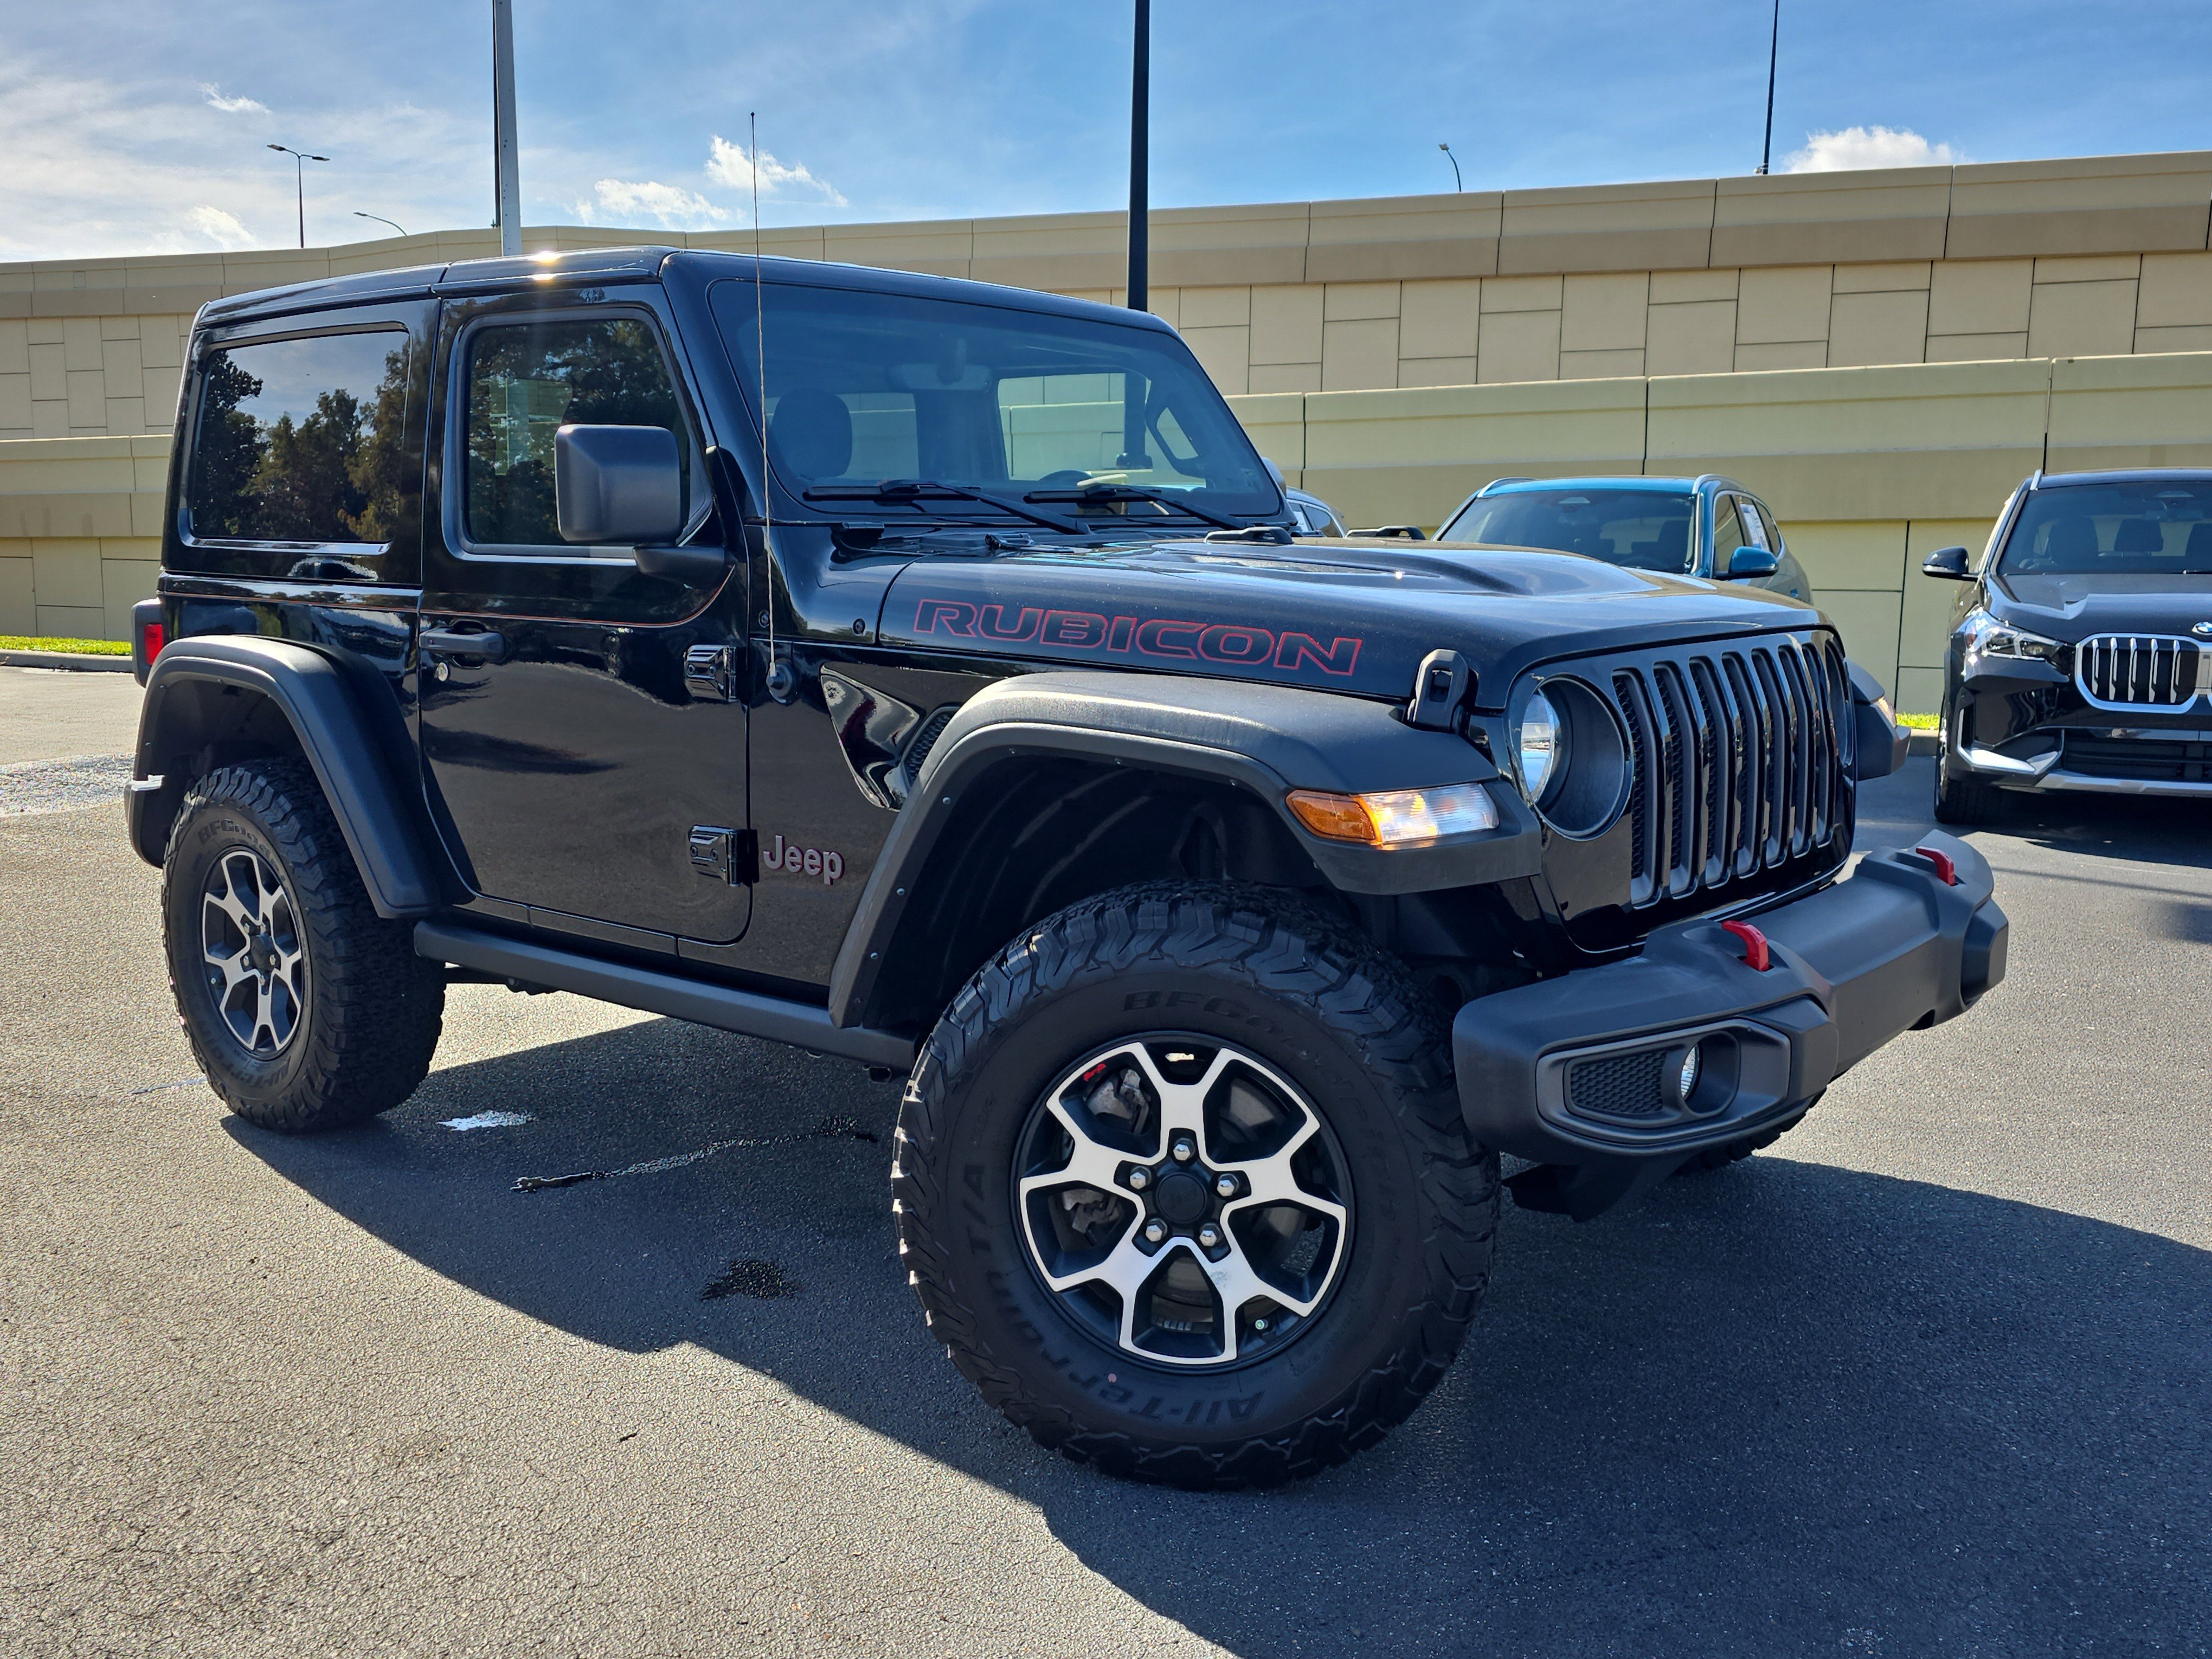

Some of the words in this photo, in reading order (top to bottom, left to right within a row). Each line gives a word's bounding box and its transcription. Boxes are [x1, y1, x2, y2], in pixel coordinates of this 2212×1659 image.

[913, 599, 1363, 676] RUBICON
[763, 834, 845, 885] Jeep
[962, 1164, 992, 1256] T/A
